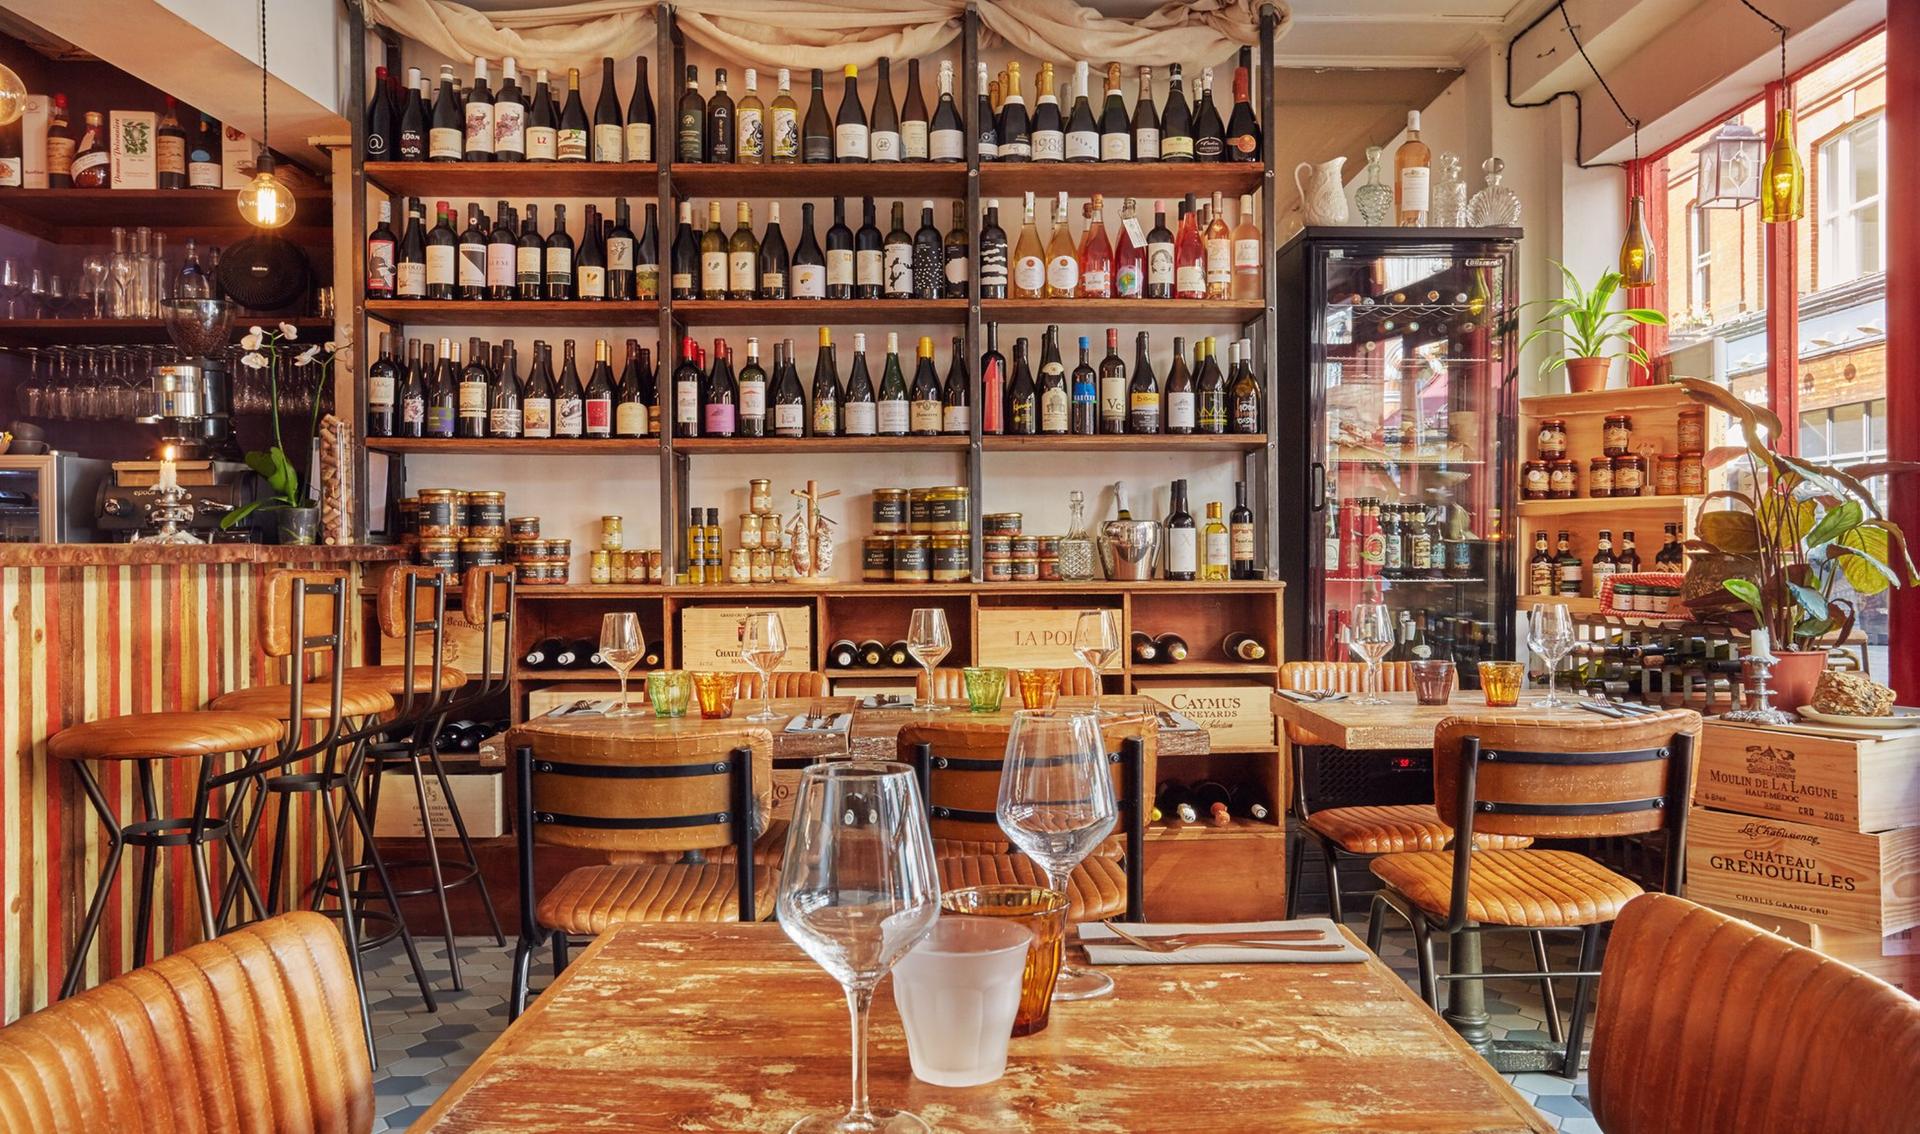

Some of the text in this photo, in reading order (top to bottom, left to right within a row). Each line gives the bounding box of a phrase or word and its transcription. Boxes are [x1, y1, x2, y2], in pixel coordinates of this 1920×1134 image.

[1016, 631, 1037, 645] LA
[1171, 694, 1241, 709] CAYMUS
[1709, 769, 1752, 786] MOULIN
[1755, 780, 1769, 789] DE
[1791, 780, 1838, 799] LAGUNE
[1743, 849, 1816, 869] CHÂTEAU
[1710, 855, 1856, 891] GRENOUILLES
[1735, 894, 1829, 915] CHABLIS GRAND CRU
